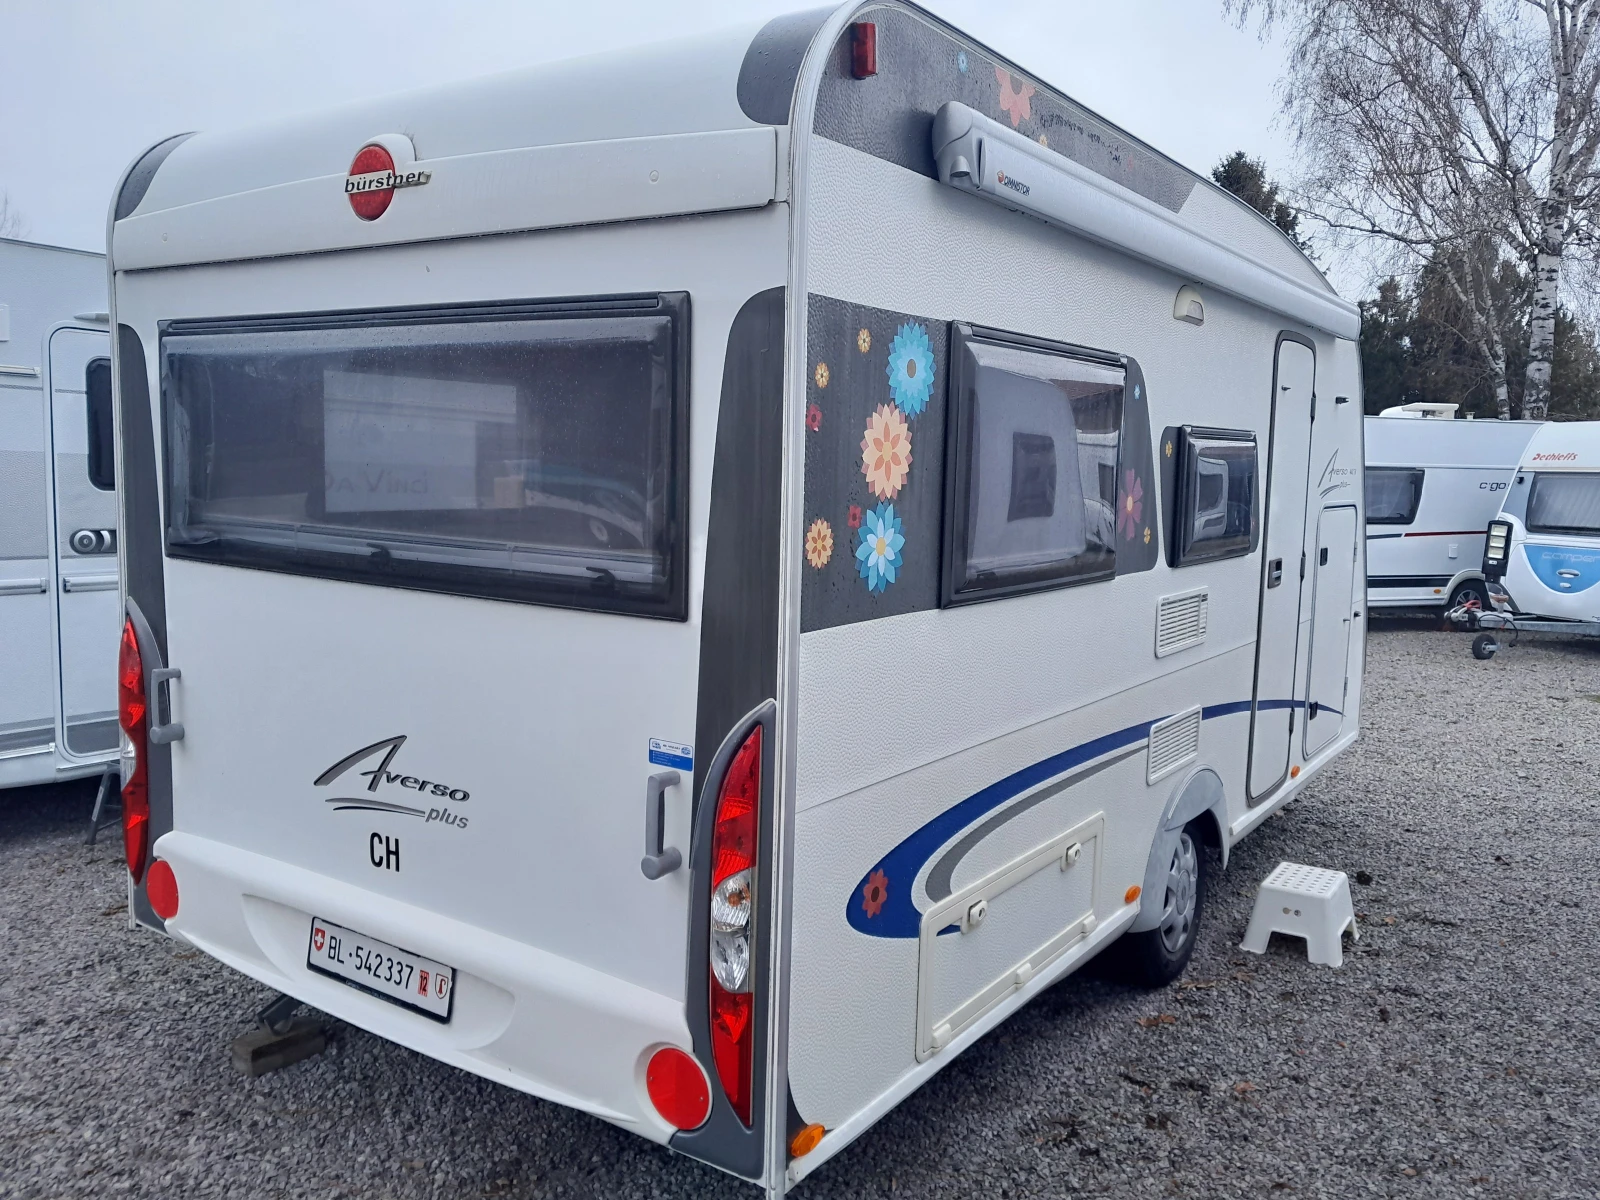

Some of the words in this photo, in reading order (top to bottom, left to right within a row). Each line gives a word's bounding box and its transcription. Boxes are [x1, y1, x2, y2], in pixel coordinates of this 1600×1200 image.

[344, 171, 425, 193] bürstner
[313, 735, 470, 802] Averso
[425, 808, 469, 829] plus
[369, 832, 400, 872] CH
